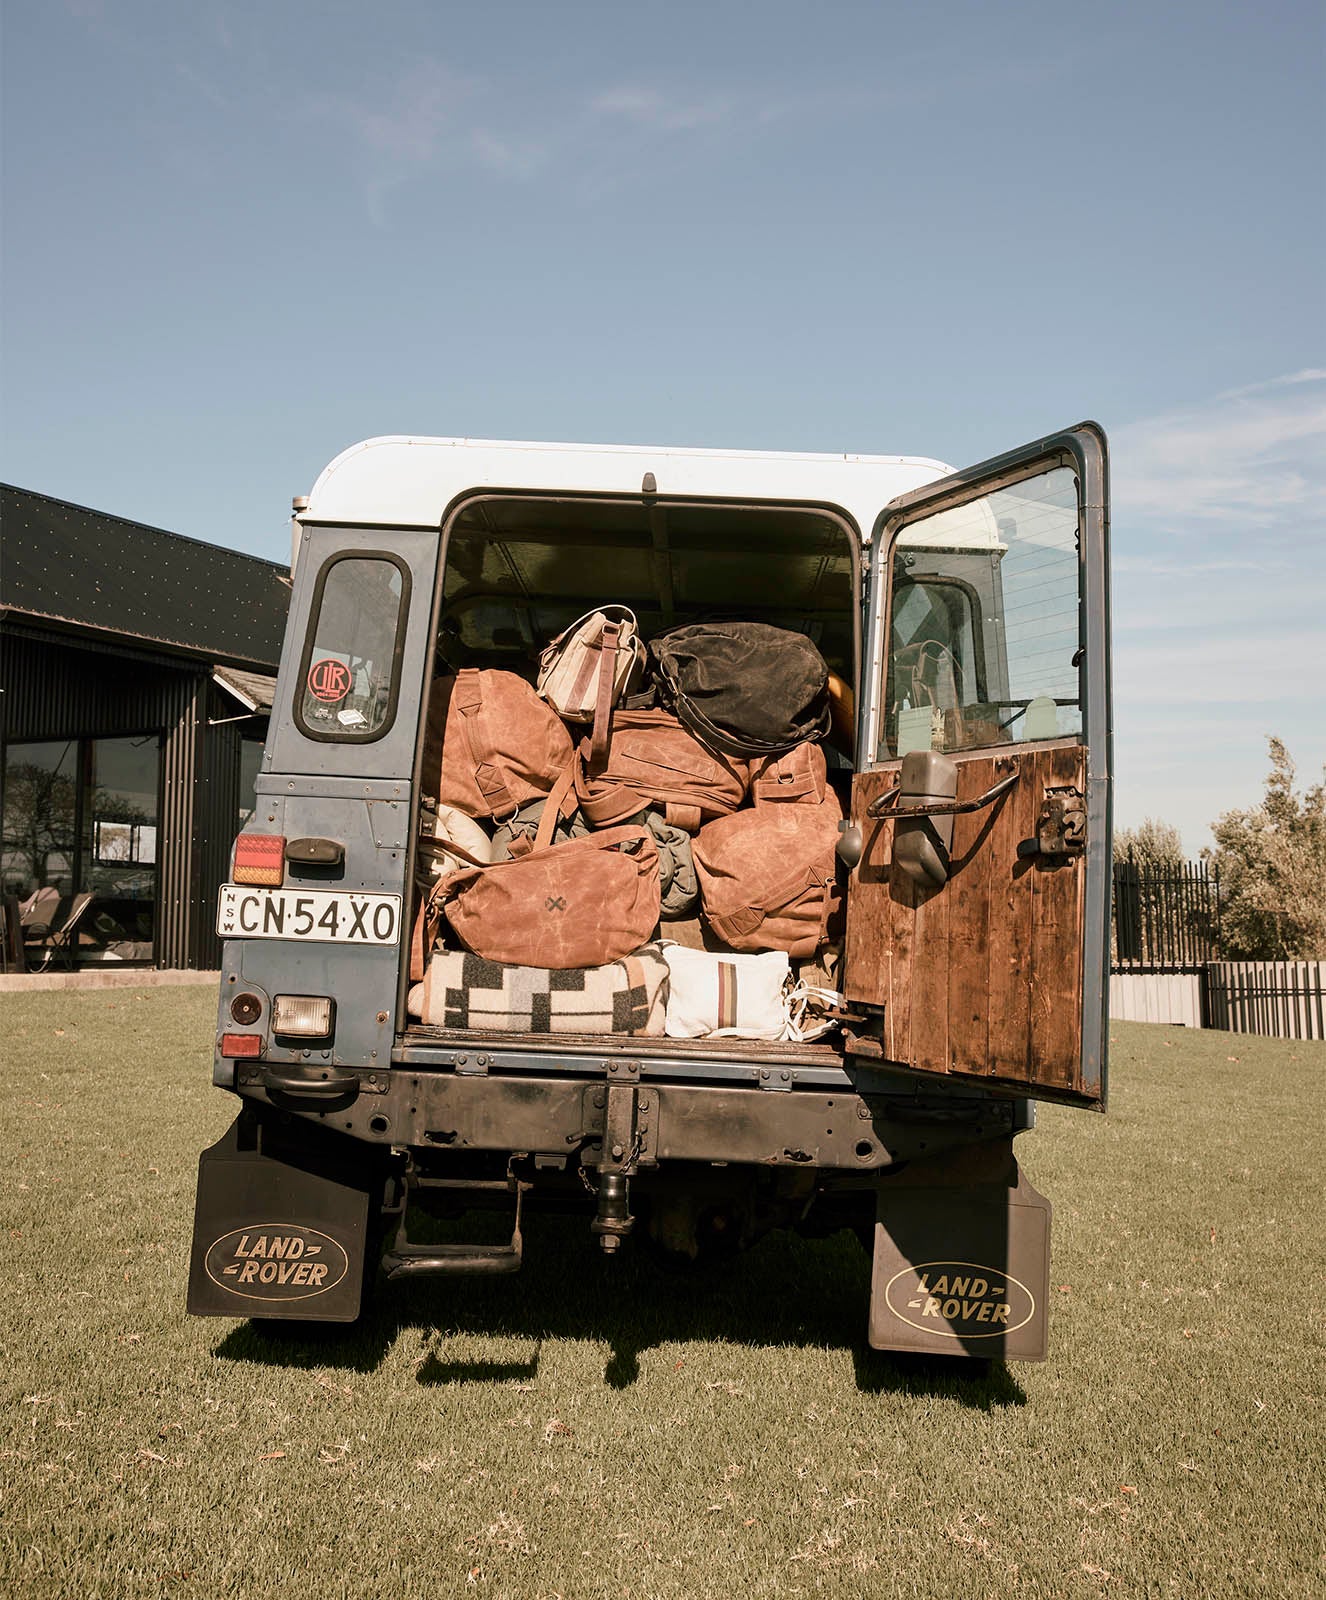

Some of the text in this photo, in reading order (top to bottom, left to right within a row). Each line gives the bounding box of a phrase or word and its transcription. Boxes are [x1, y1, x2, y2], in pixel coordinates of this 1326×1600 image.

[234, 1235, 304, 1260] LAND
[237, 1260, 328, 1286] ROVER
[916, 1273, 988, 1298] LAND
[921, 1296, 1011, 1324] ROVER
